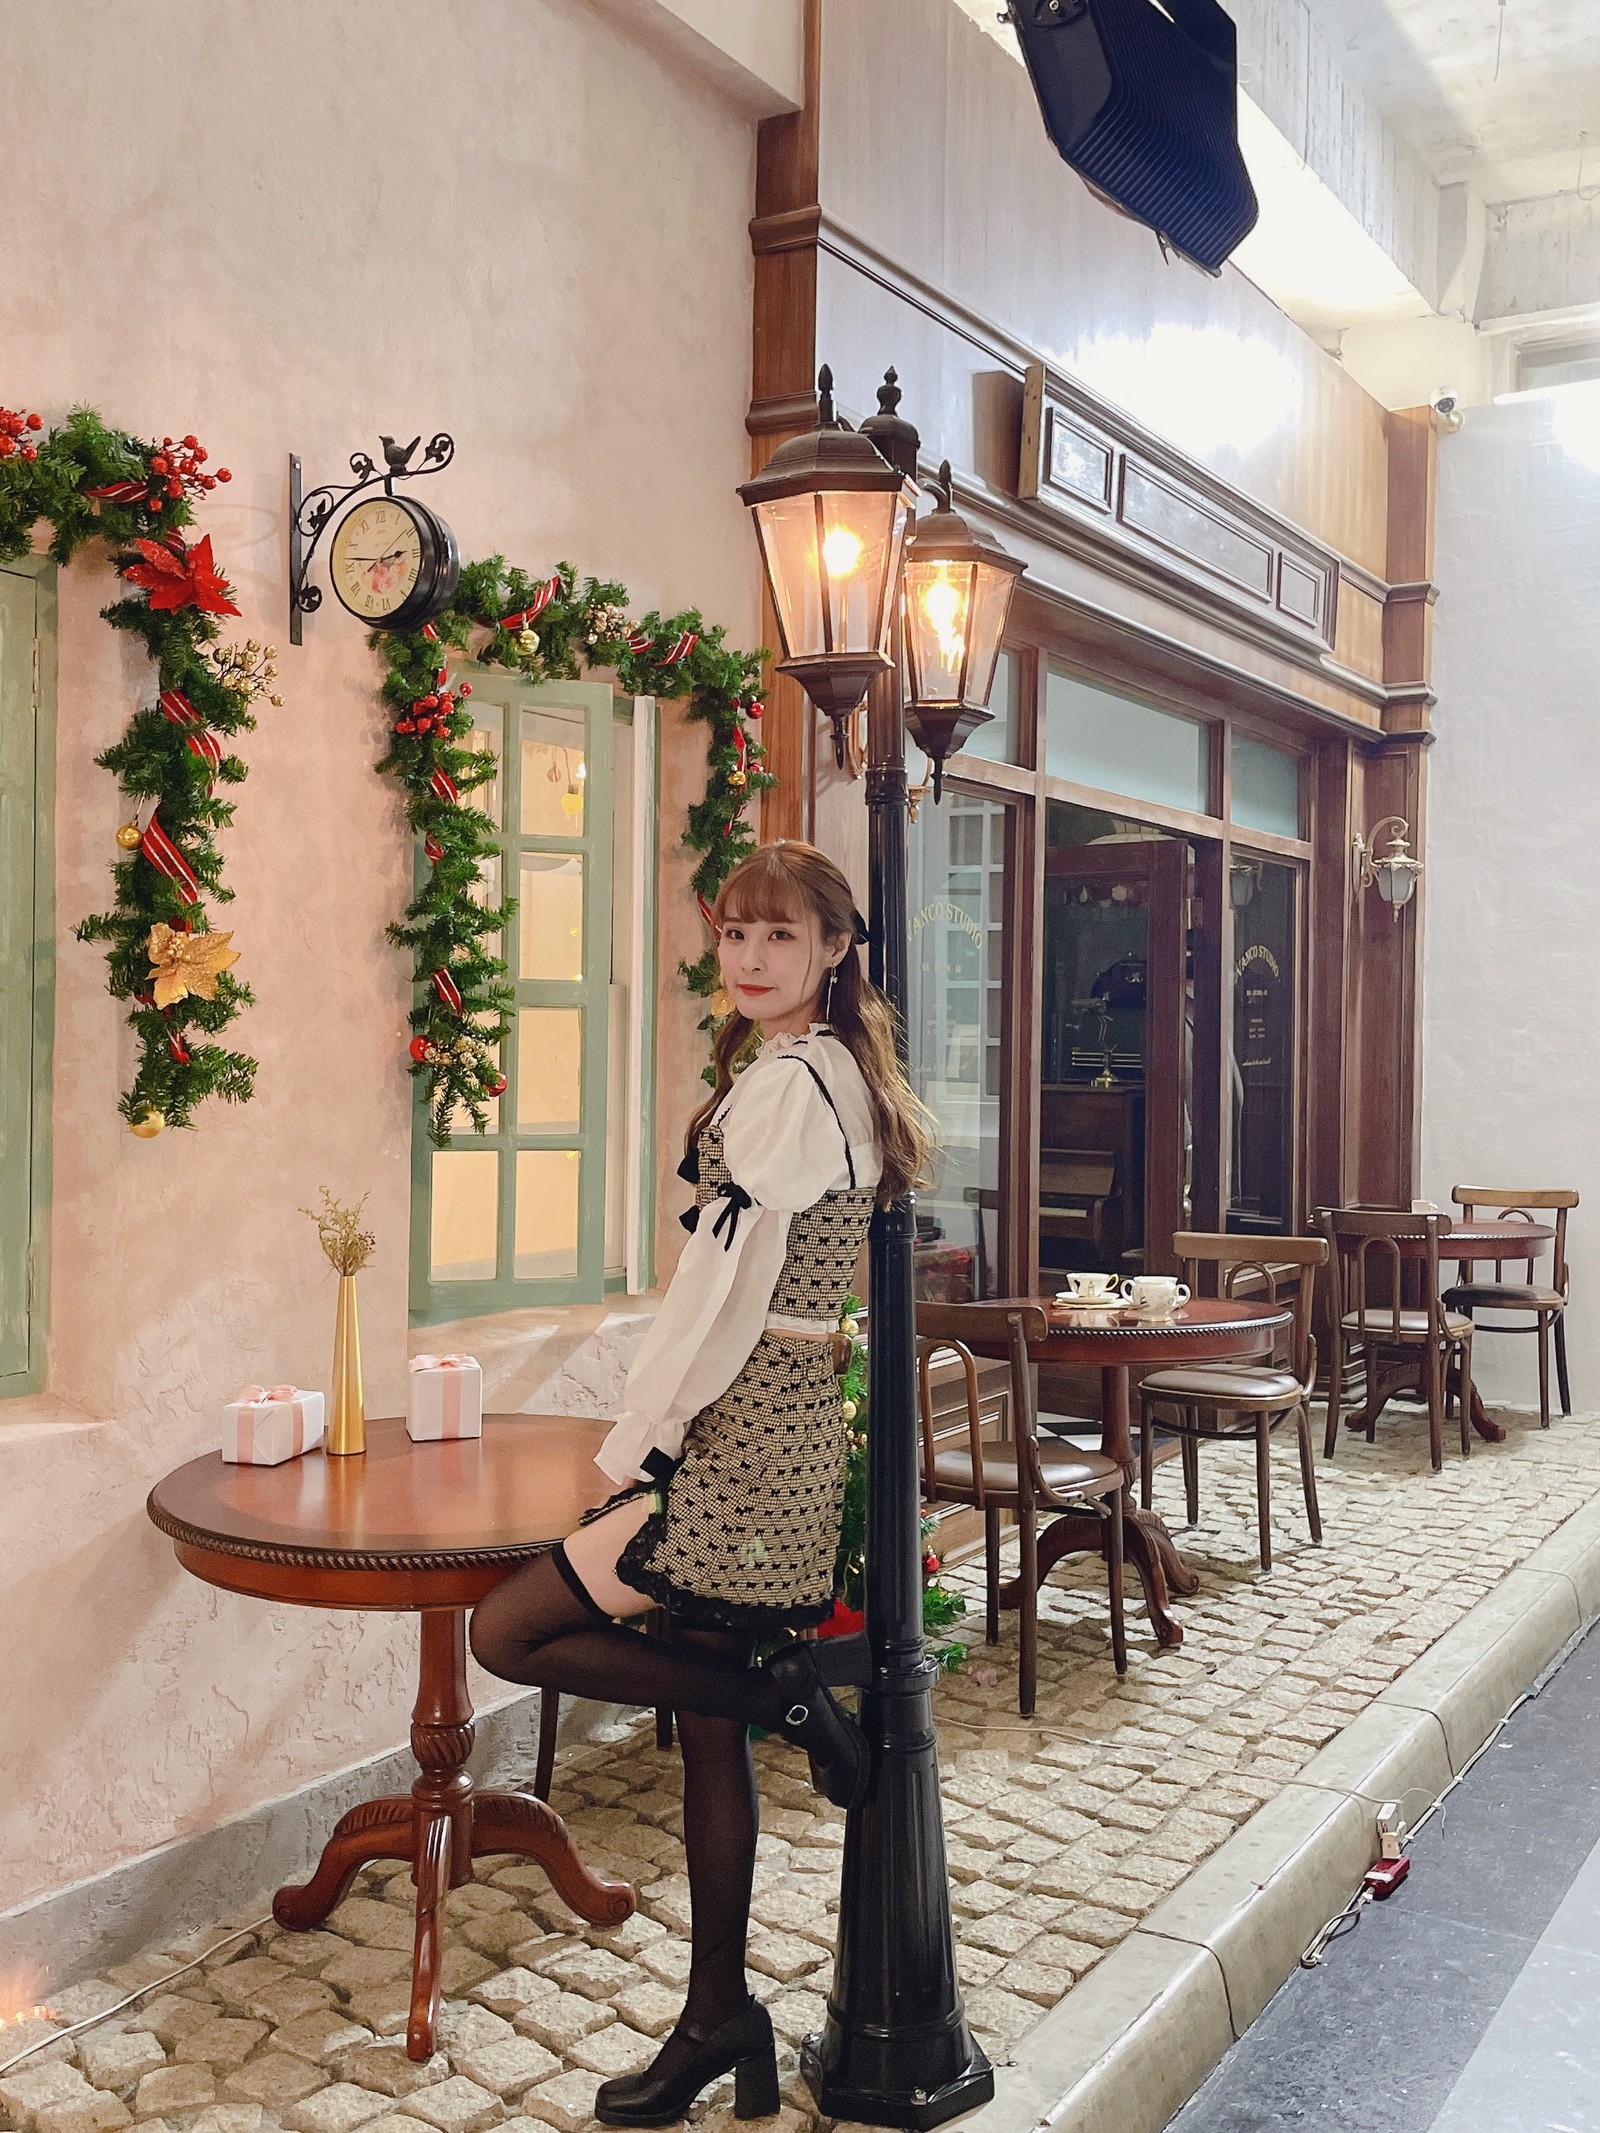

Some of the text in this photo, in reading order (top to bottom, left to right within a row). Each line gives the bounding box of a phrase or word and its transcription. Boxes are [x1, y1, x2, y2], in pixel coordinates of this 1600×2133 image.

[375, 510, 386, 524] XII
[946, 902, 983, 949] STUDIO
[1258, 945, 1279, 977] STUDIO
